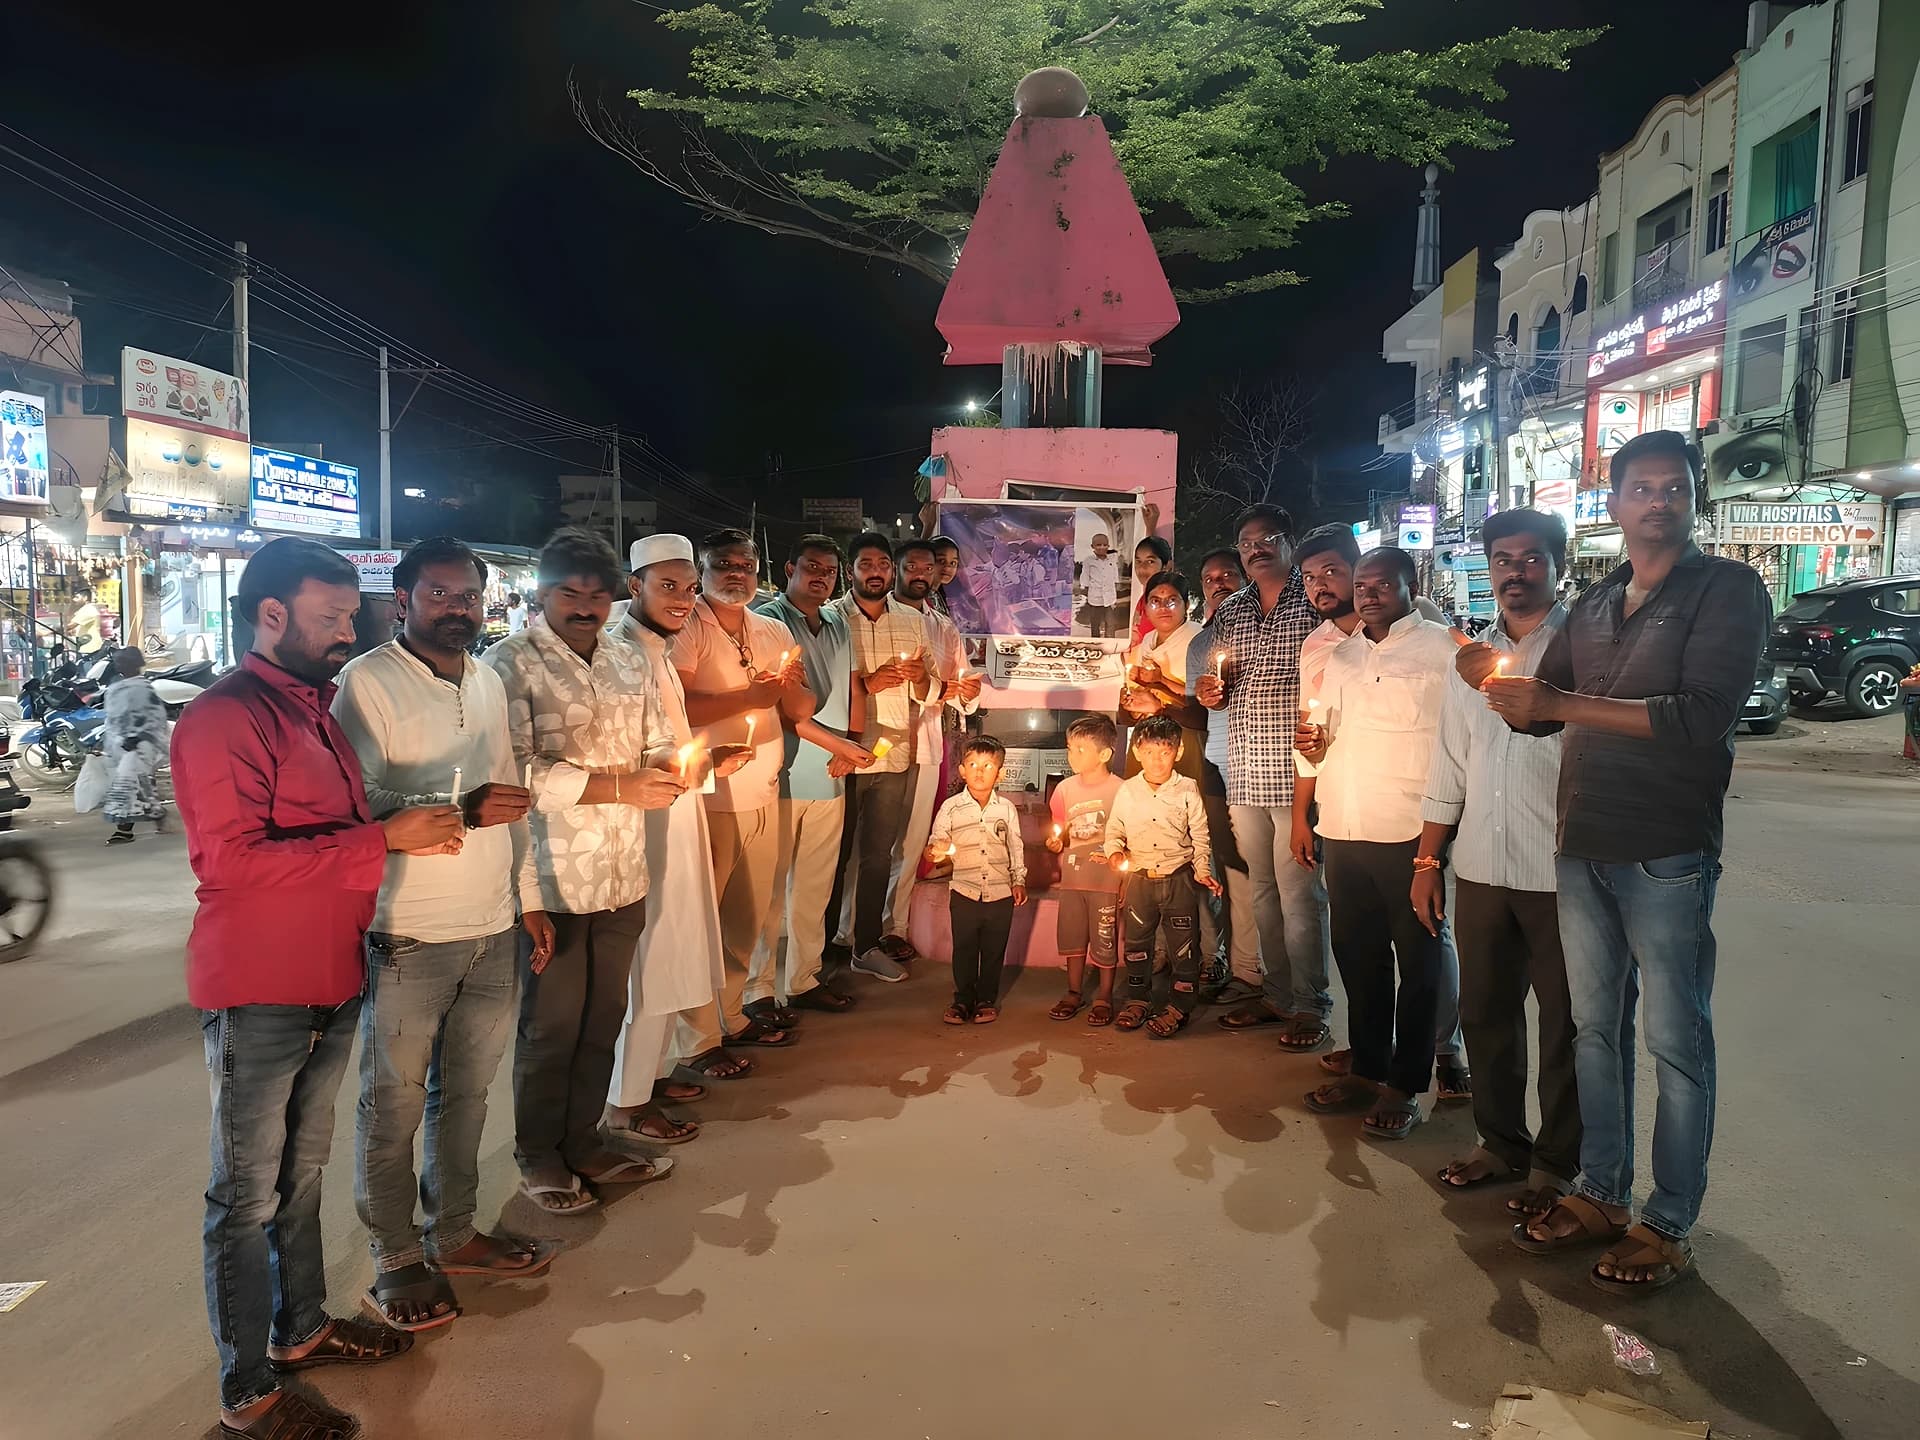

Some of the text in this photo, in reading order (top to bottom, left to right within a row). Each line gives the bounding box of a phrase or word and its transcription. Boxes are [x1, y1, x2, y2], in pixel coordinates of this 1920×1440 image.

[297, 470, 325, 488] MOBILE
[326, 475, 347, 492] ZONE
[1732, 506, 1760, 522] VNR
[1761, 506, 1833, 522] HOSPITALS
[1731, 525, 1854, 542] EMERGENCY
